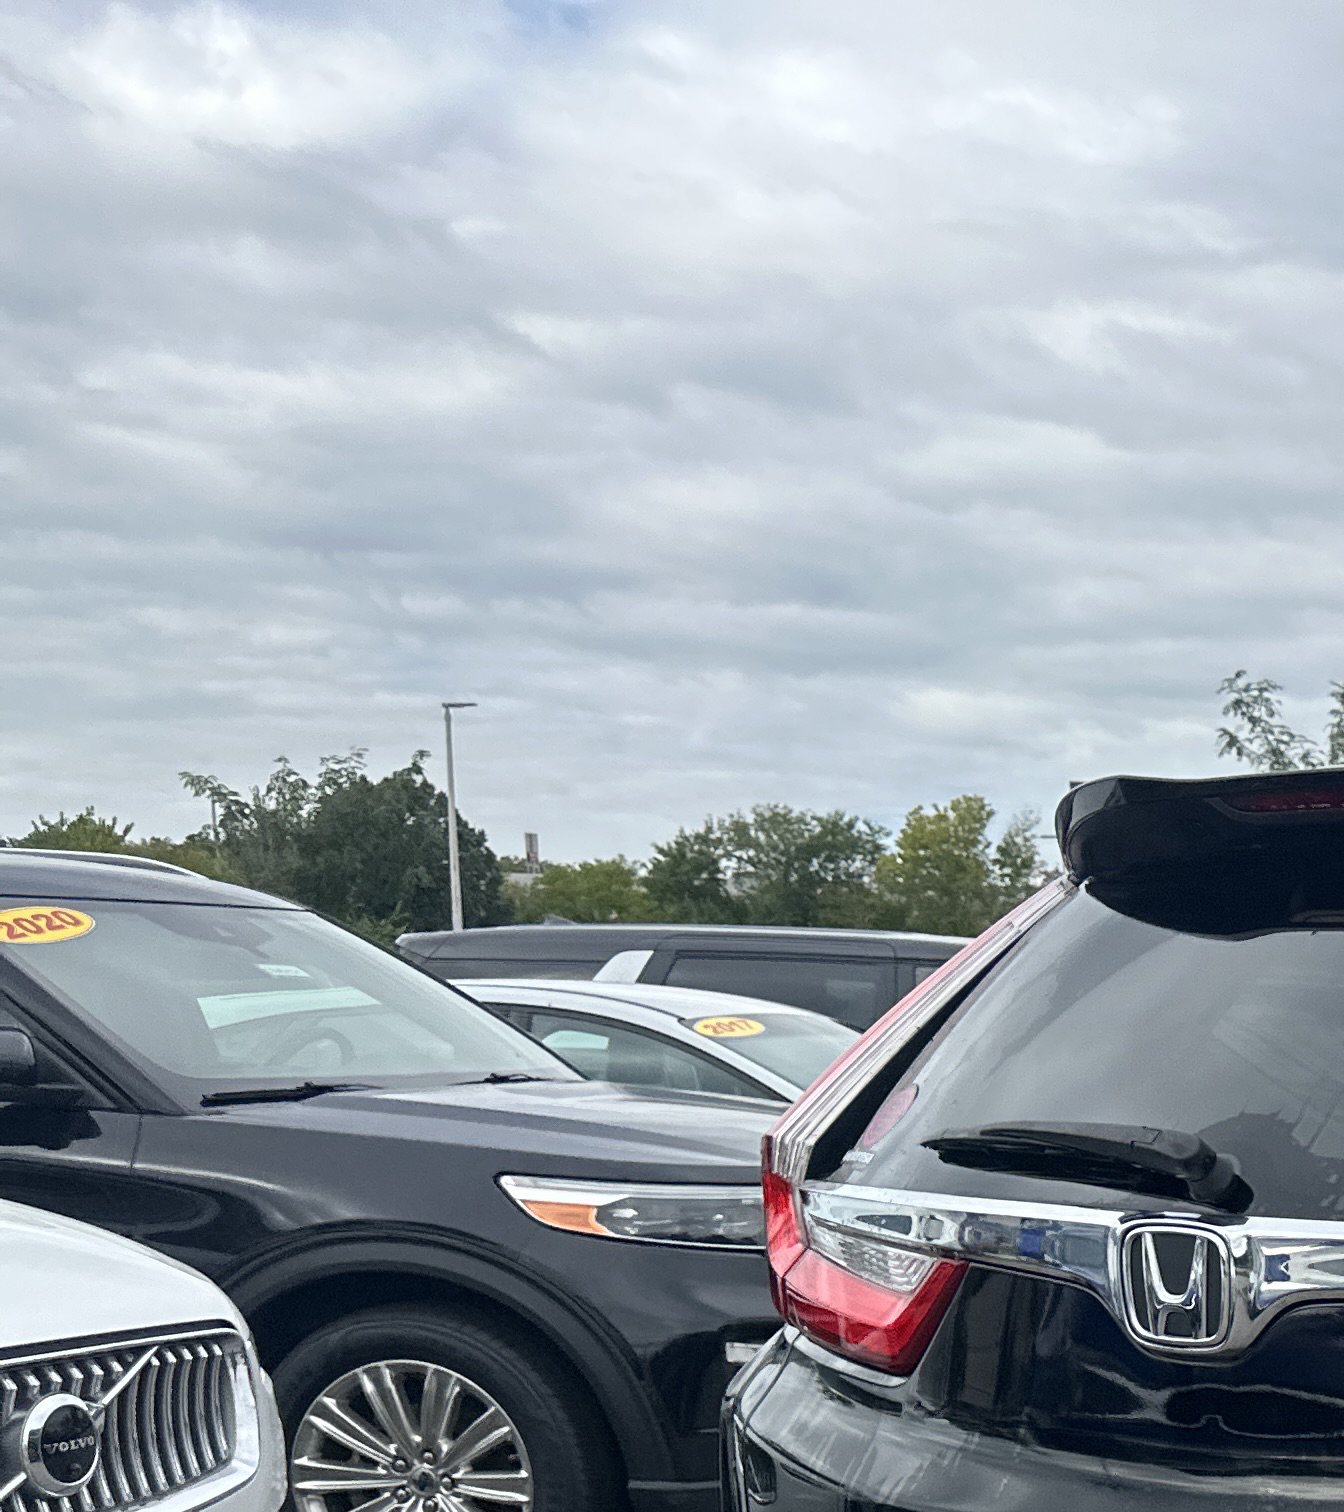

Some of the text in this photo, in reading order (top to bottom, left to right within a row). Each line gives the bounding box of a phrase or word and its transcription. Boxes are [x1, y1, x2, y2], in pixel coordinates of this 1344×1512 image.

[0, 910, 84, 939] 2020
[703, 1020, 753, 1035] 2017
[43, 1435, 95, 1455] VOLVO
